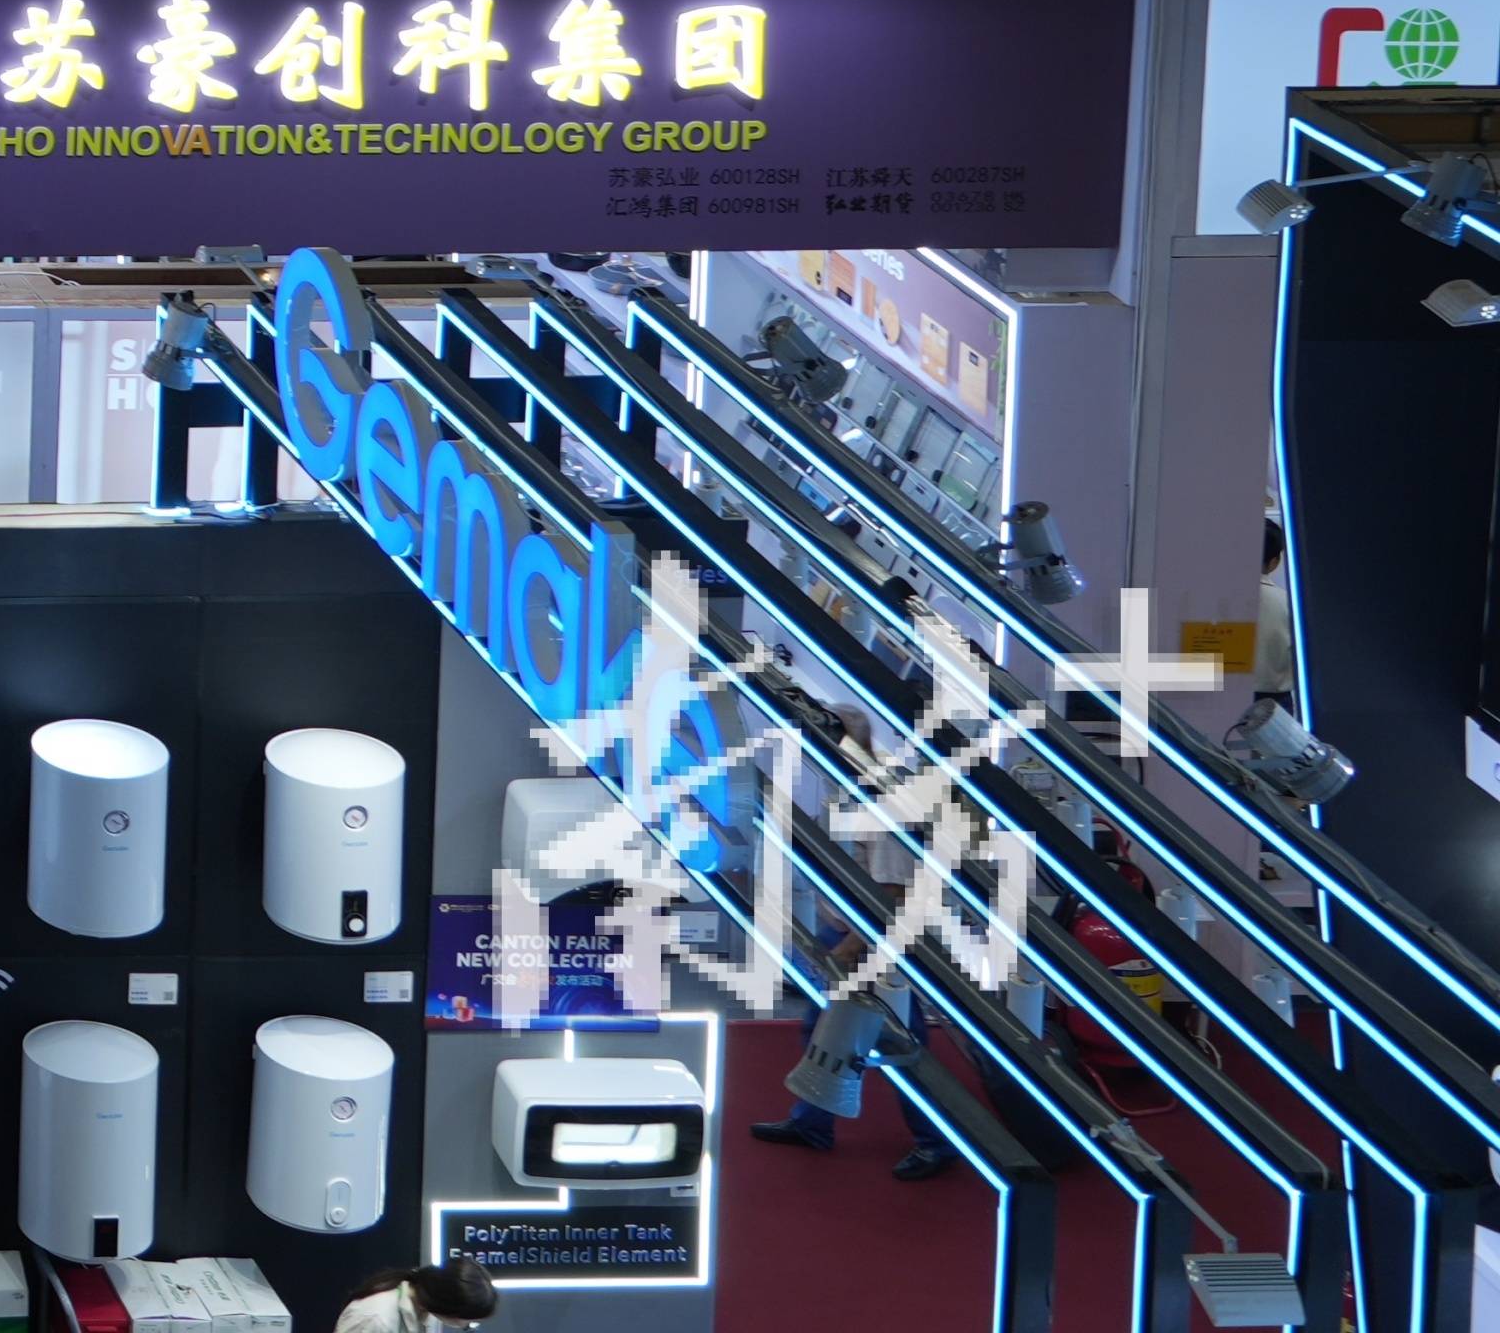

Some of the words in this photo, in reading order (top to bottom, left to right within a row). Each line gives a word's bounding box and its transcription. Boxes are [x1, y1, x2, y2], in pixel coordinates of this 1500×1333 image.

[65, 120, 616, 158] INNOVATION&TECHNOLOGY
[622, 119, 768, 152] GROUP
[607, 167, 701, 189] 苏豪弘业
[708, 167, 801, 186] 600128SH
[825, 167, 914, 189] 江苏舜天
[930, 166, 1027, 184] 600287SH
[606, 195, 699, 218] 汇鸿集团
[707, 197, 801, 216] 600981SH
[475, 933, 561, 951] CANTON
[566, 933, 611, 951] FAIR
[456, 952, 503, 968] NEW
[507, 952, 634, 969] COLLECTION
[463, 1223, 560, 1246] PolyTitan
[564, 1224, 619, 1241] Inner
[624, 1223, 672, 1241] Tank
[597, 1245, 687, 1264] Element
